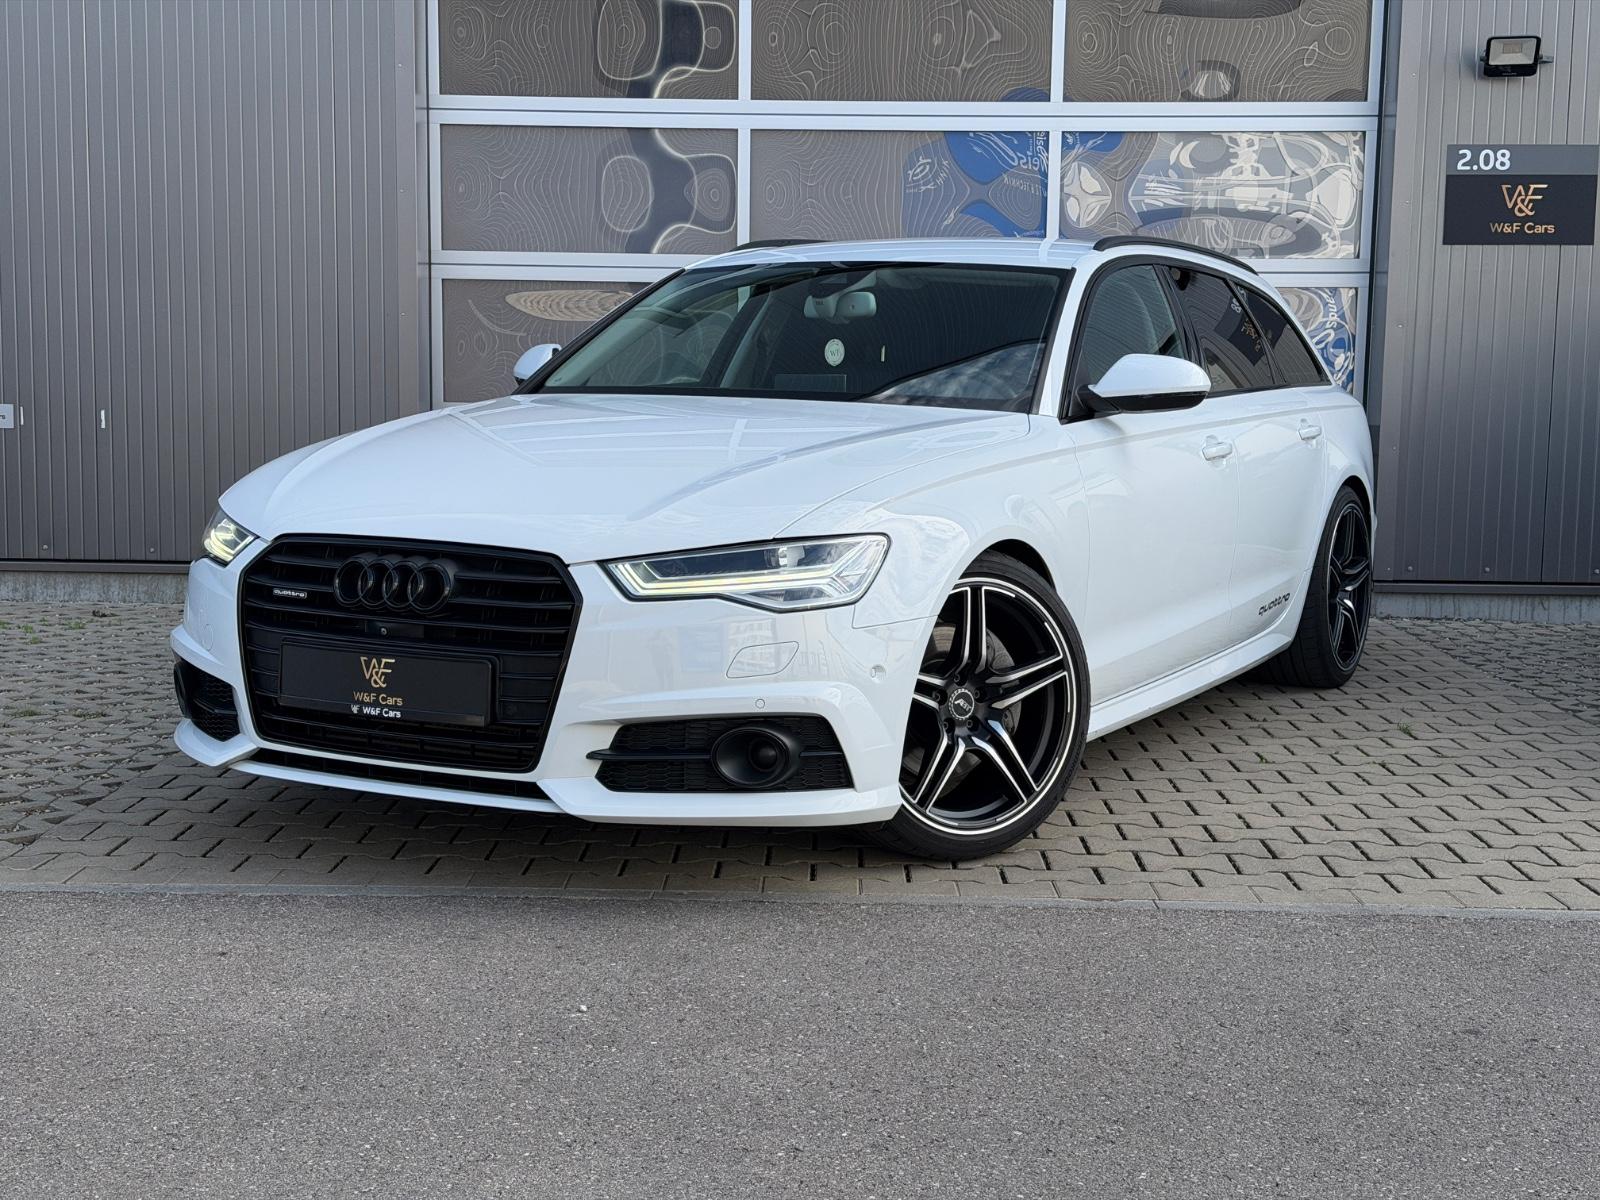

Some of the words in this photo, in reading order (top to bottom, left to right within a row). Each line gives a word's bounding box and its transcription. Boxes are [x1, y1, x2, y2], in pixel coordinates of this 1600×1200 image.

[1456, 149, 1511, 171] 2.08
[1490, 223, 1521, 234] W&F
[1524, 222, 1555, 234] Cars
[273, 589, 306, 598] quattro
[1258, 592, 1290, 616] quattro
[353, 691, 377, 703] W&F
[379, 694, 403, 706] Cars
[363, 706, 381, 716] W&F
[382, 708, 401, 718] Cars
